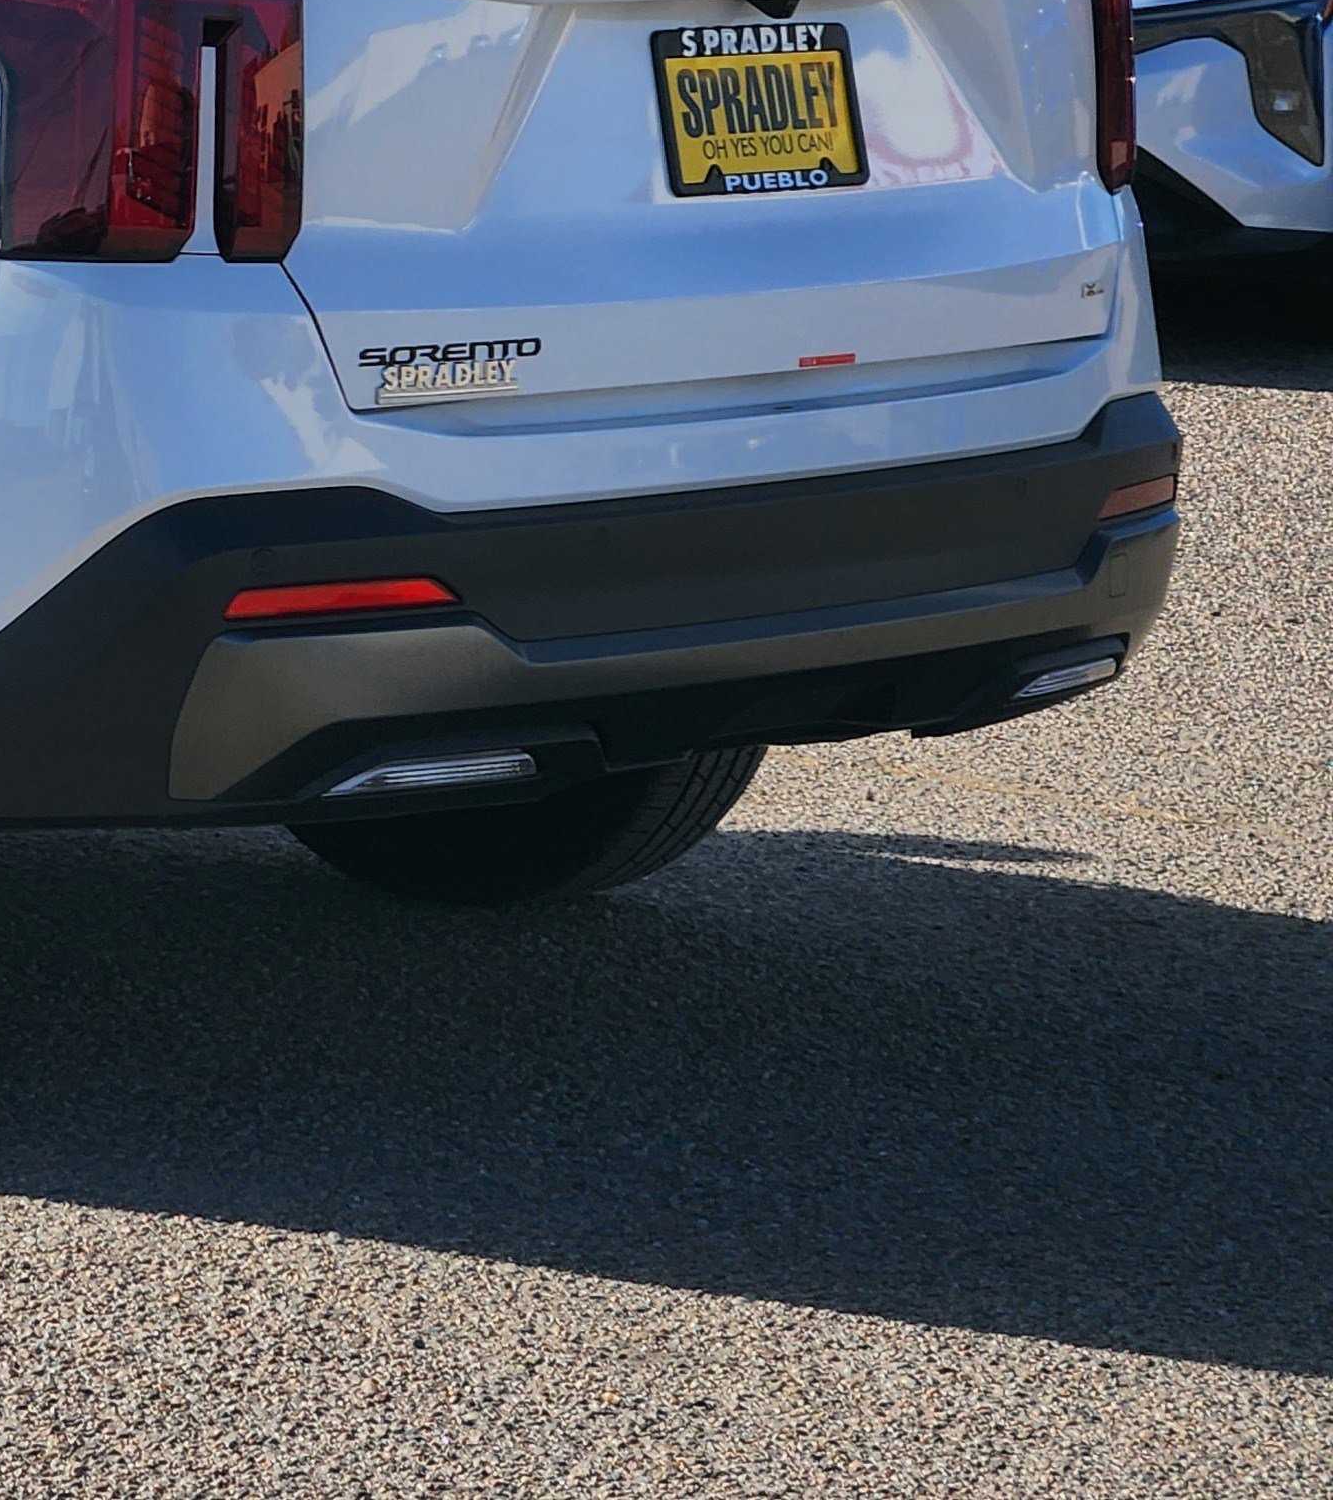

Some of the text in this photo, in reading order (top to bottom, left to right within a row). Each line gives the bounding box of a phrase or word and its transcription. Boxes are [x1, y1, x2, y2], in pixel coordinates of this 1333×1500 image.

[681, 24, 825, 58] SPRADLEY
[676, 61, 839, 138] SPRADLEY
[702, 132, 834, 160] OH YES YOU CAN!
[724, 168, 829, 192] PUEBLO
[358, 337, 542, 368] SORENTO
[382, 357, 518, 391] SPRADLEY
